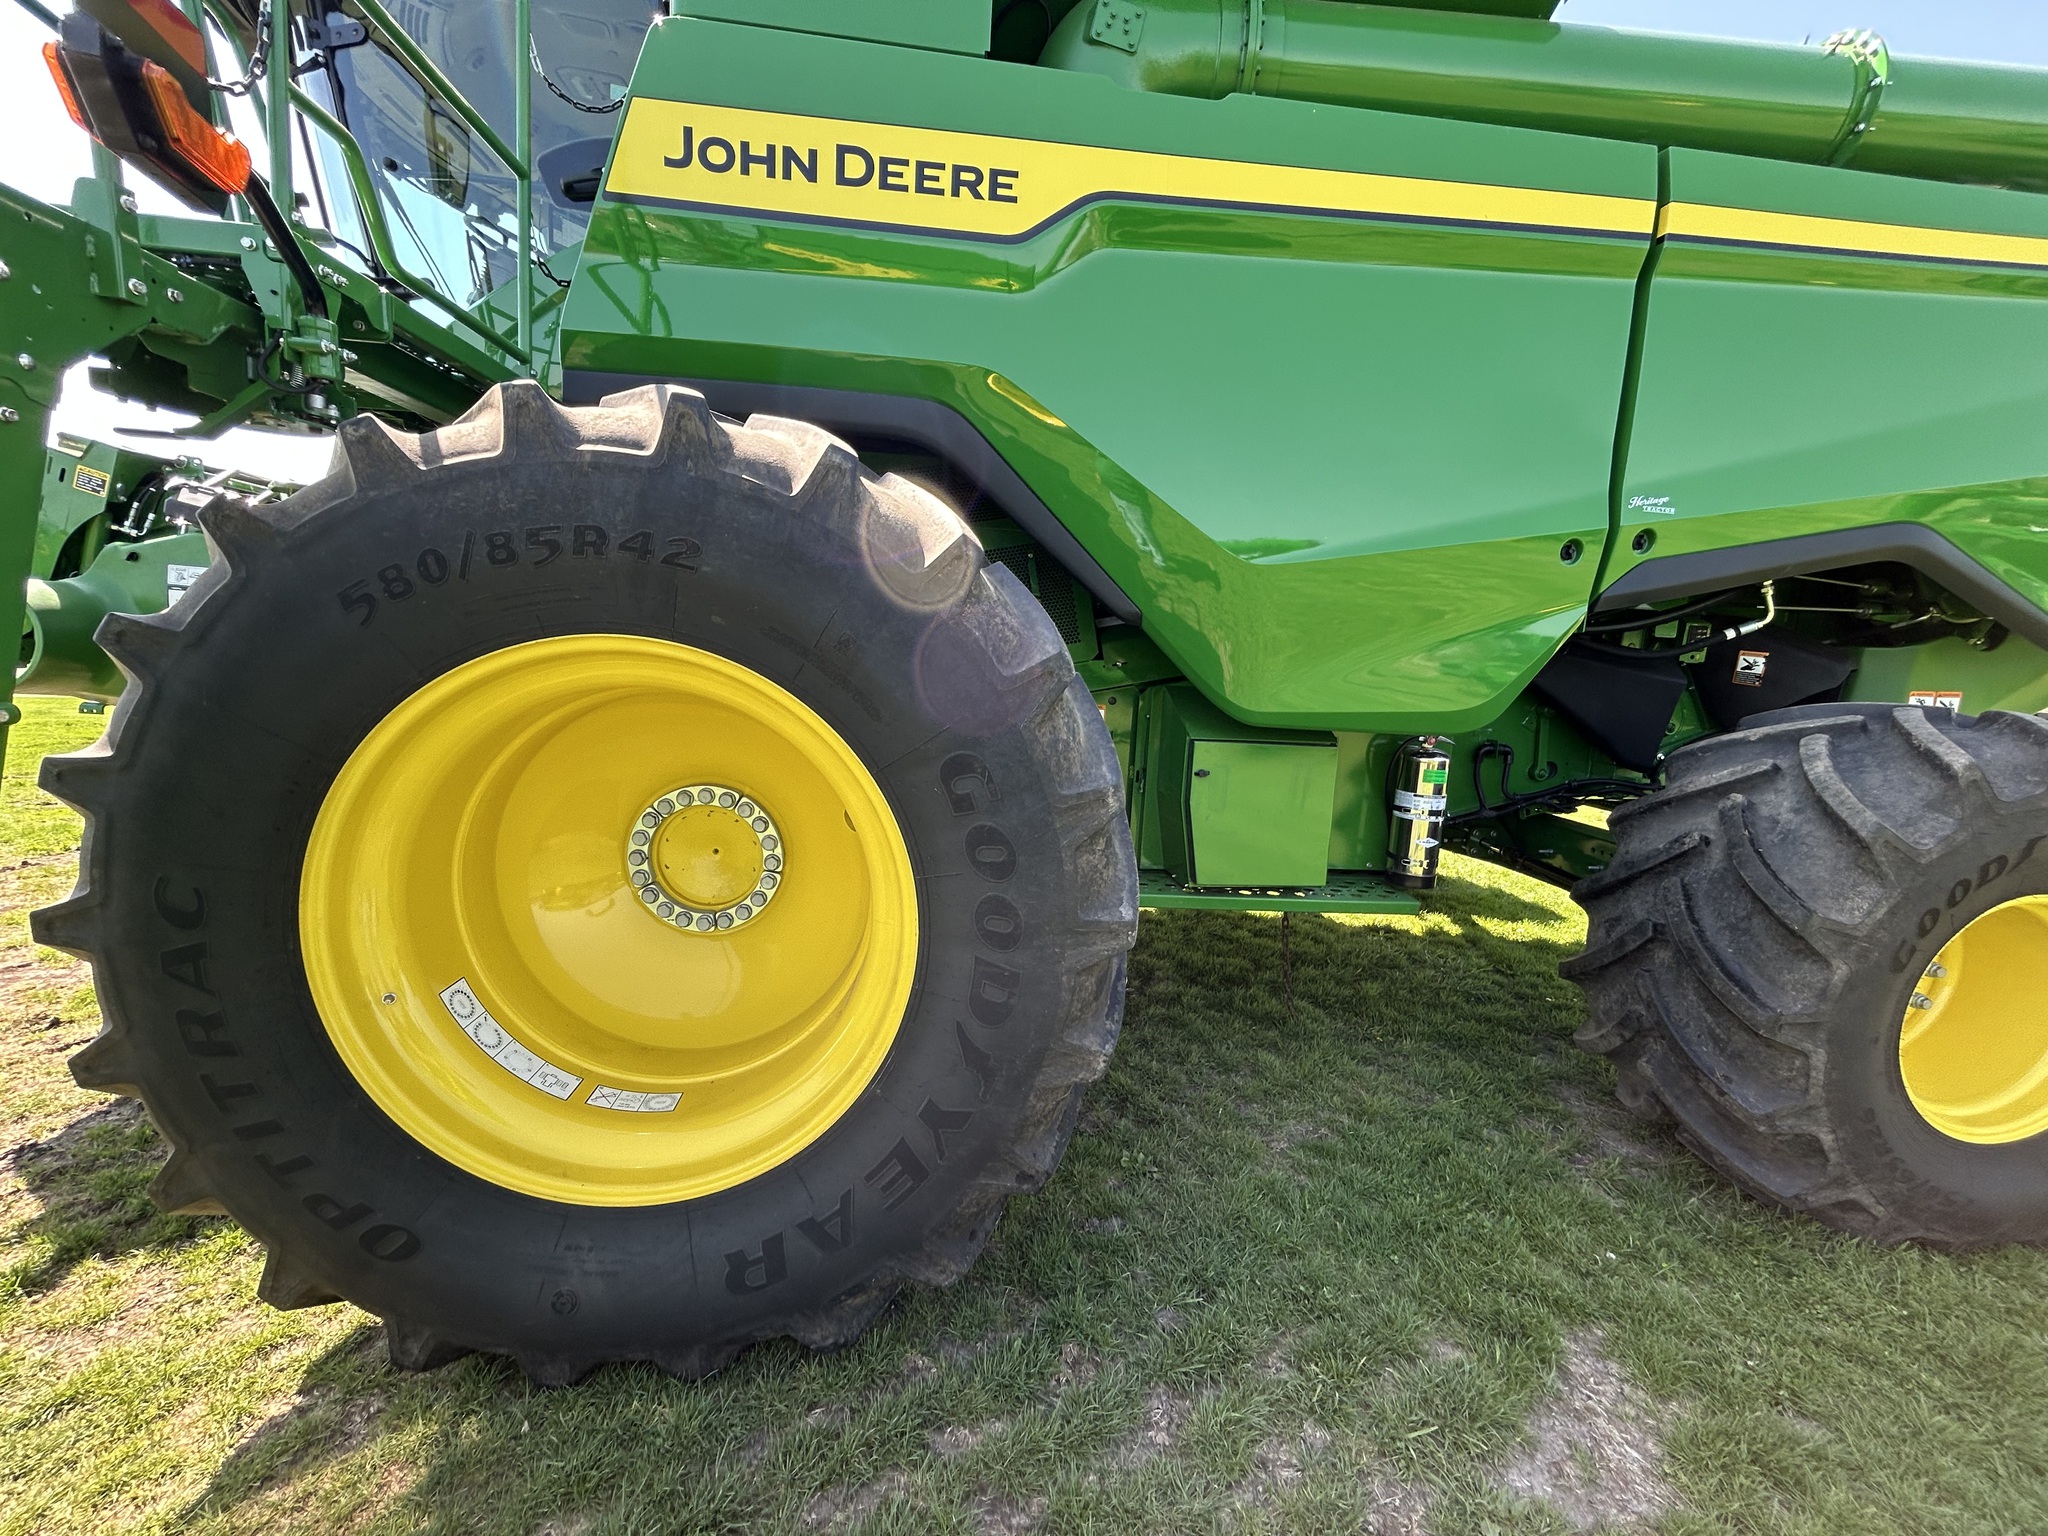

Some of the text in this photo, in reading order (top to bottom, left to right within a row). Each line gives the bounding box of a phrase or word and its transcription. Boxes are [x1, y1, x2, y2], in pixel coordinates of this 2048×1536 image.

[663, 125, 1019, 204] JOHN DEERE
[1628, 495, 1669, 508] Heritage
[1643, 506, 1675, 514] TRACTOR
[336, 523, 703, 628] 580/85R42
[153, 873, 424, 1263] OPTITRAC
[722, 750, 1024, 1296] GOODYEAR
